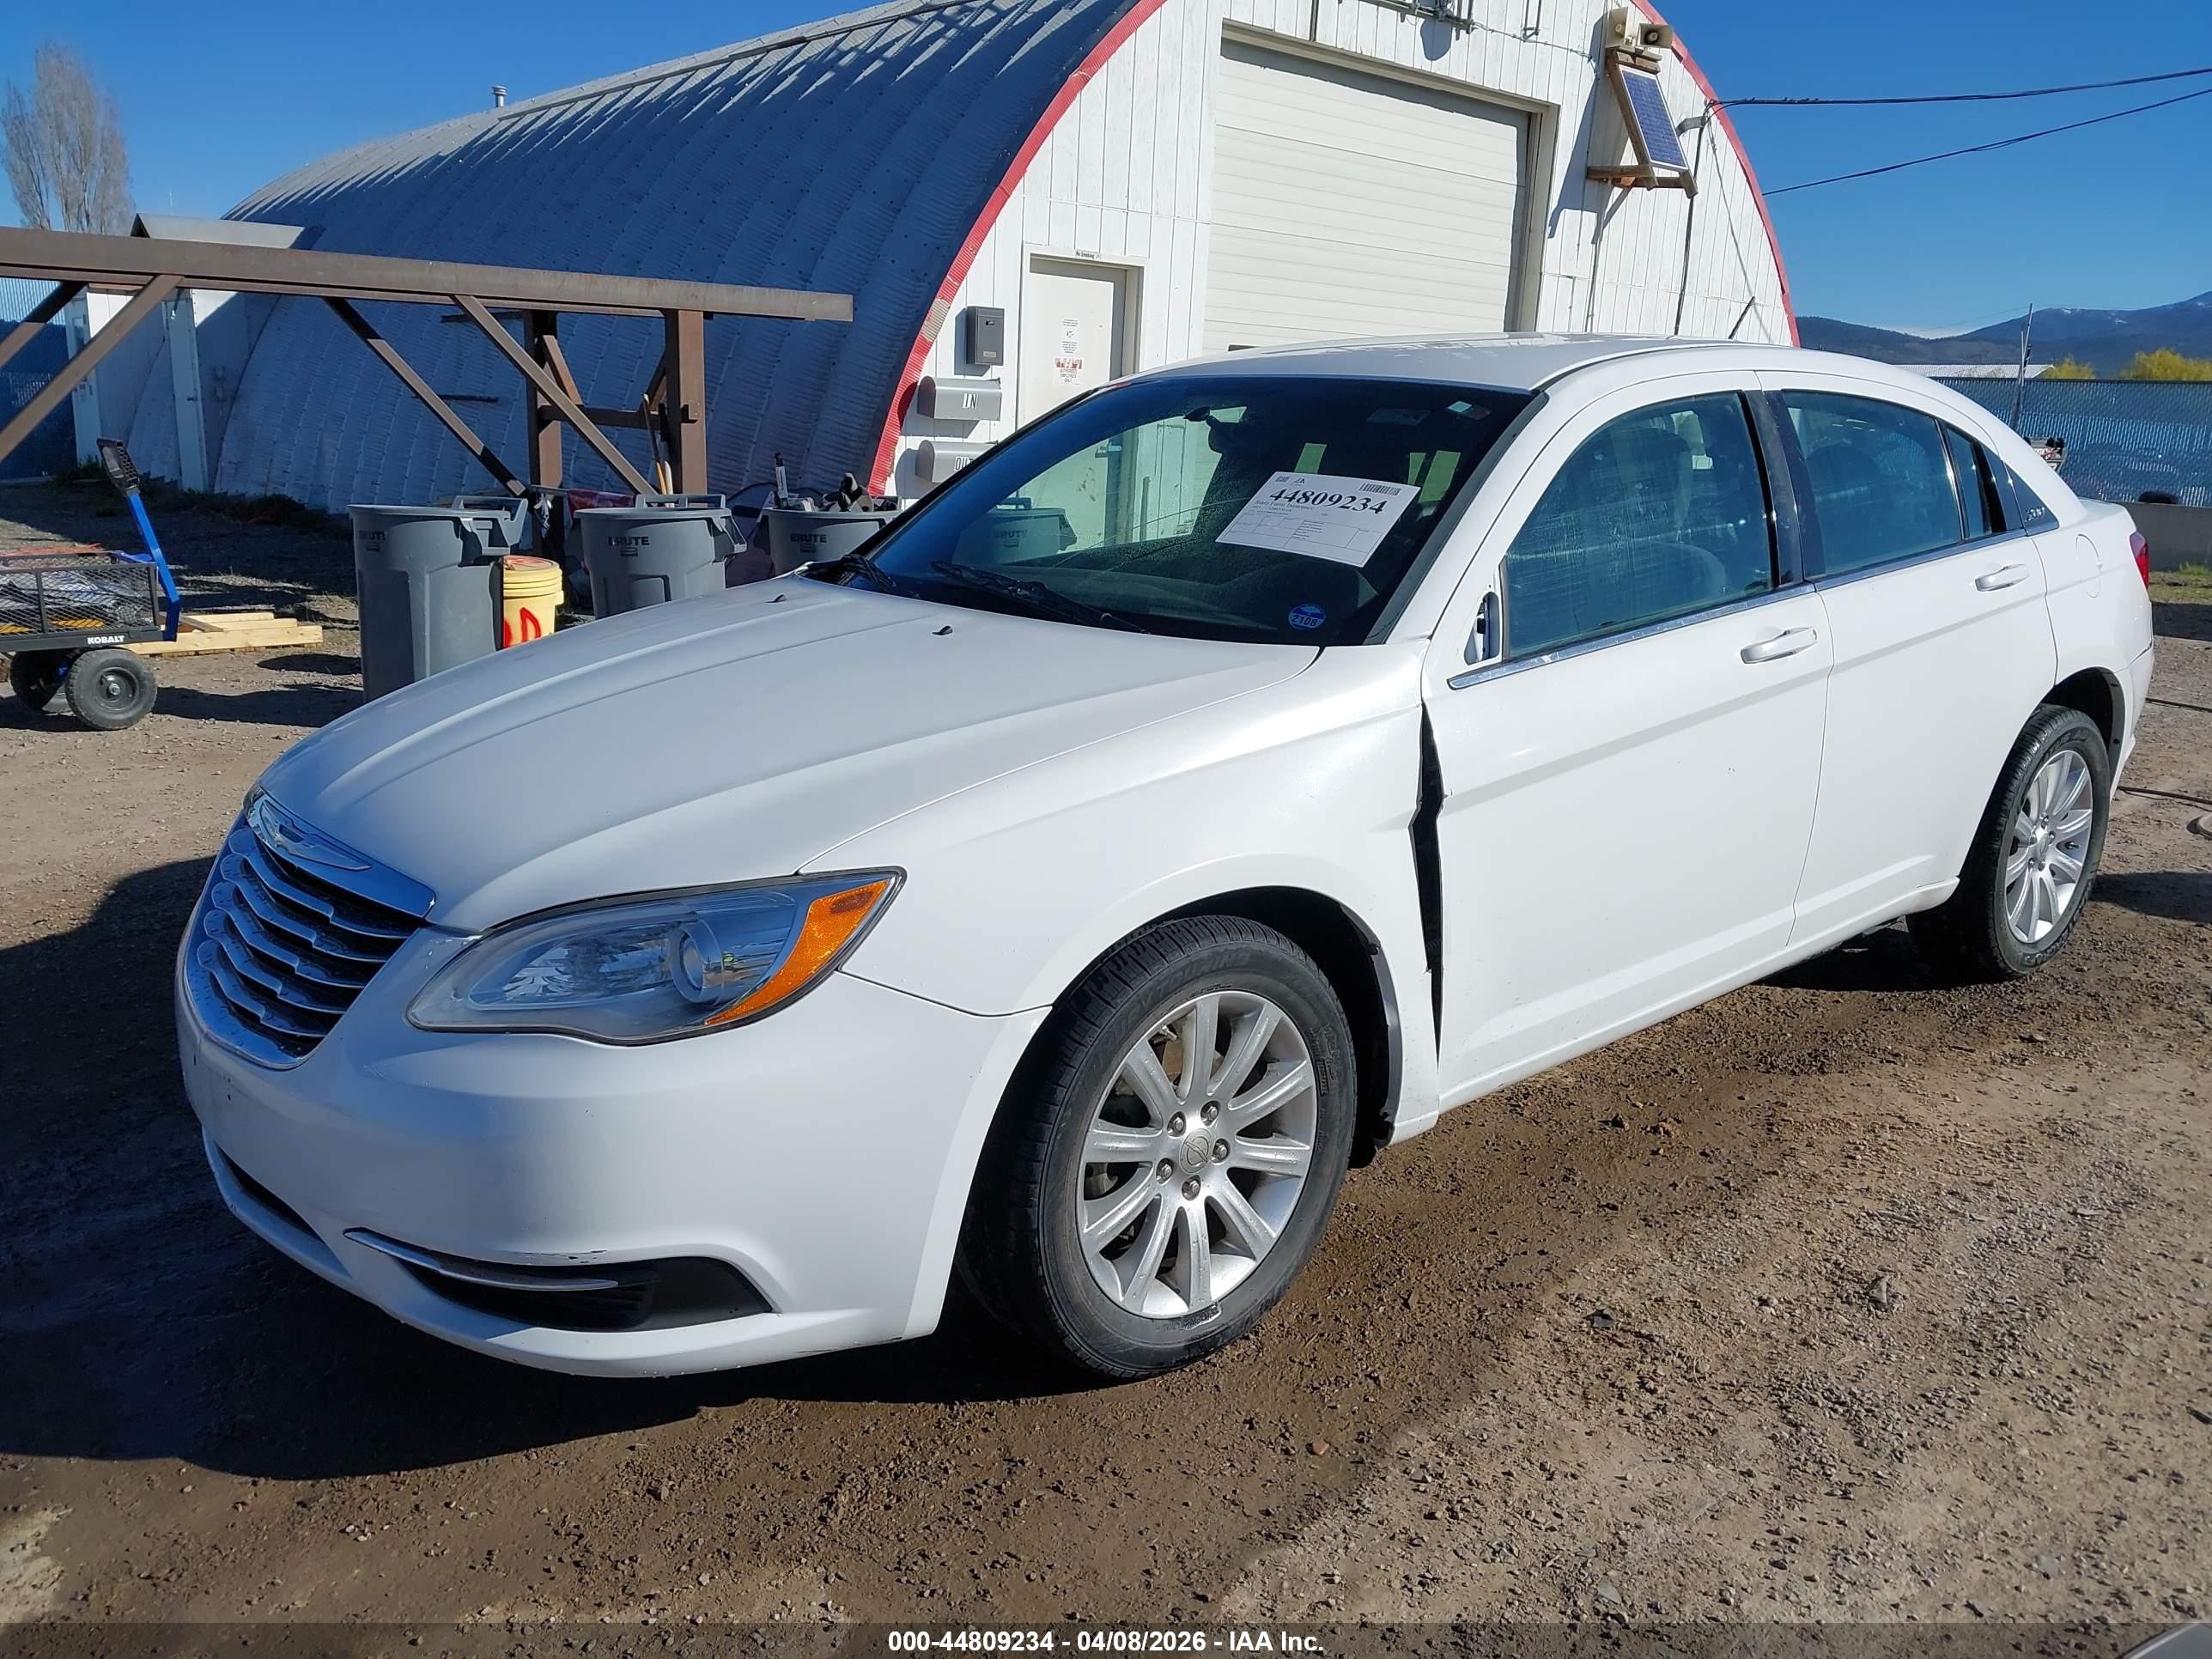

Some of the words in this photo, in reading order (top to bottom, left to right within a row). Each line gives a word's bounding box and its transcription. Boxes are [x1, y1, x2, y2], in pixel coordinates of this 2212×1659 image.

[965, 393, 977, 409] IN
[1269, 488, 1389, 514] 44809234
[608, 536, 650, 546] BRUTE
[790, 533, 828, 544] BRUTE
[87, 635, 125, 645] KOBALT
